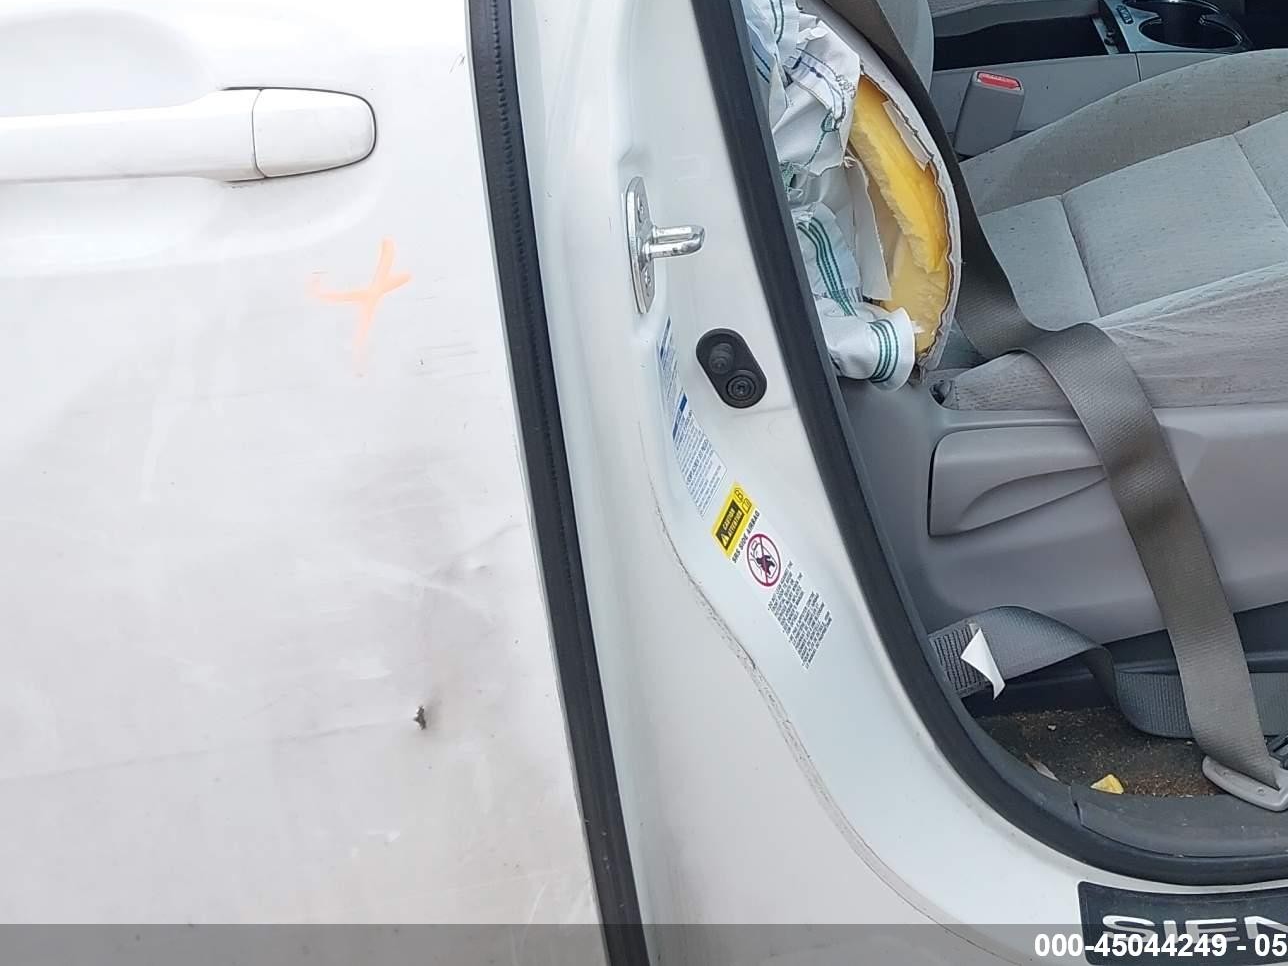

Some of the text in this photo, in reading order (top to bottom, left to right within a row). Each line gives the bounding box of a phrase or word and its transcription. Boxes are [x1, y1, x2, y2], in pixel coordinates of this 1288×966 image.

[722, 506, 736, 531] CAUTION
[732, 509, 761, 564] SRS SIDE AIRBAG
